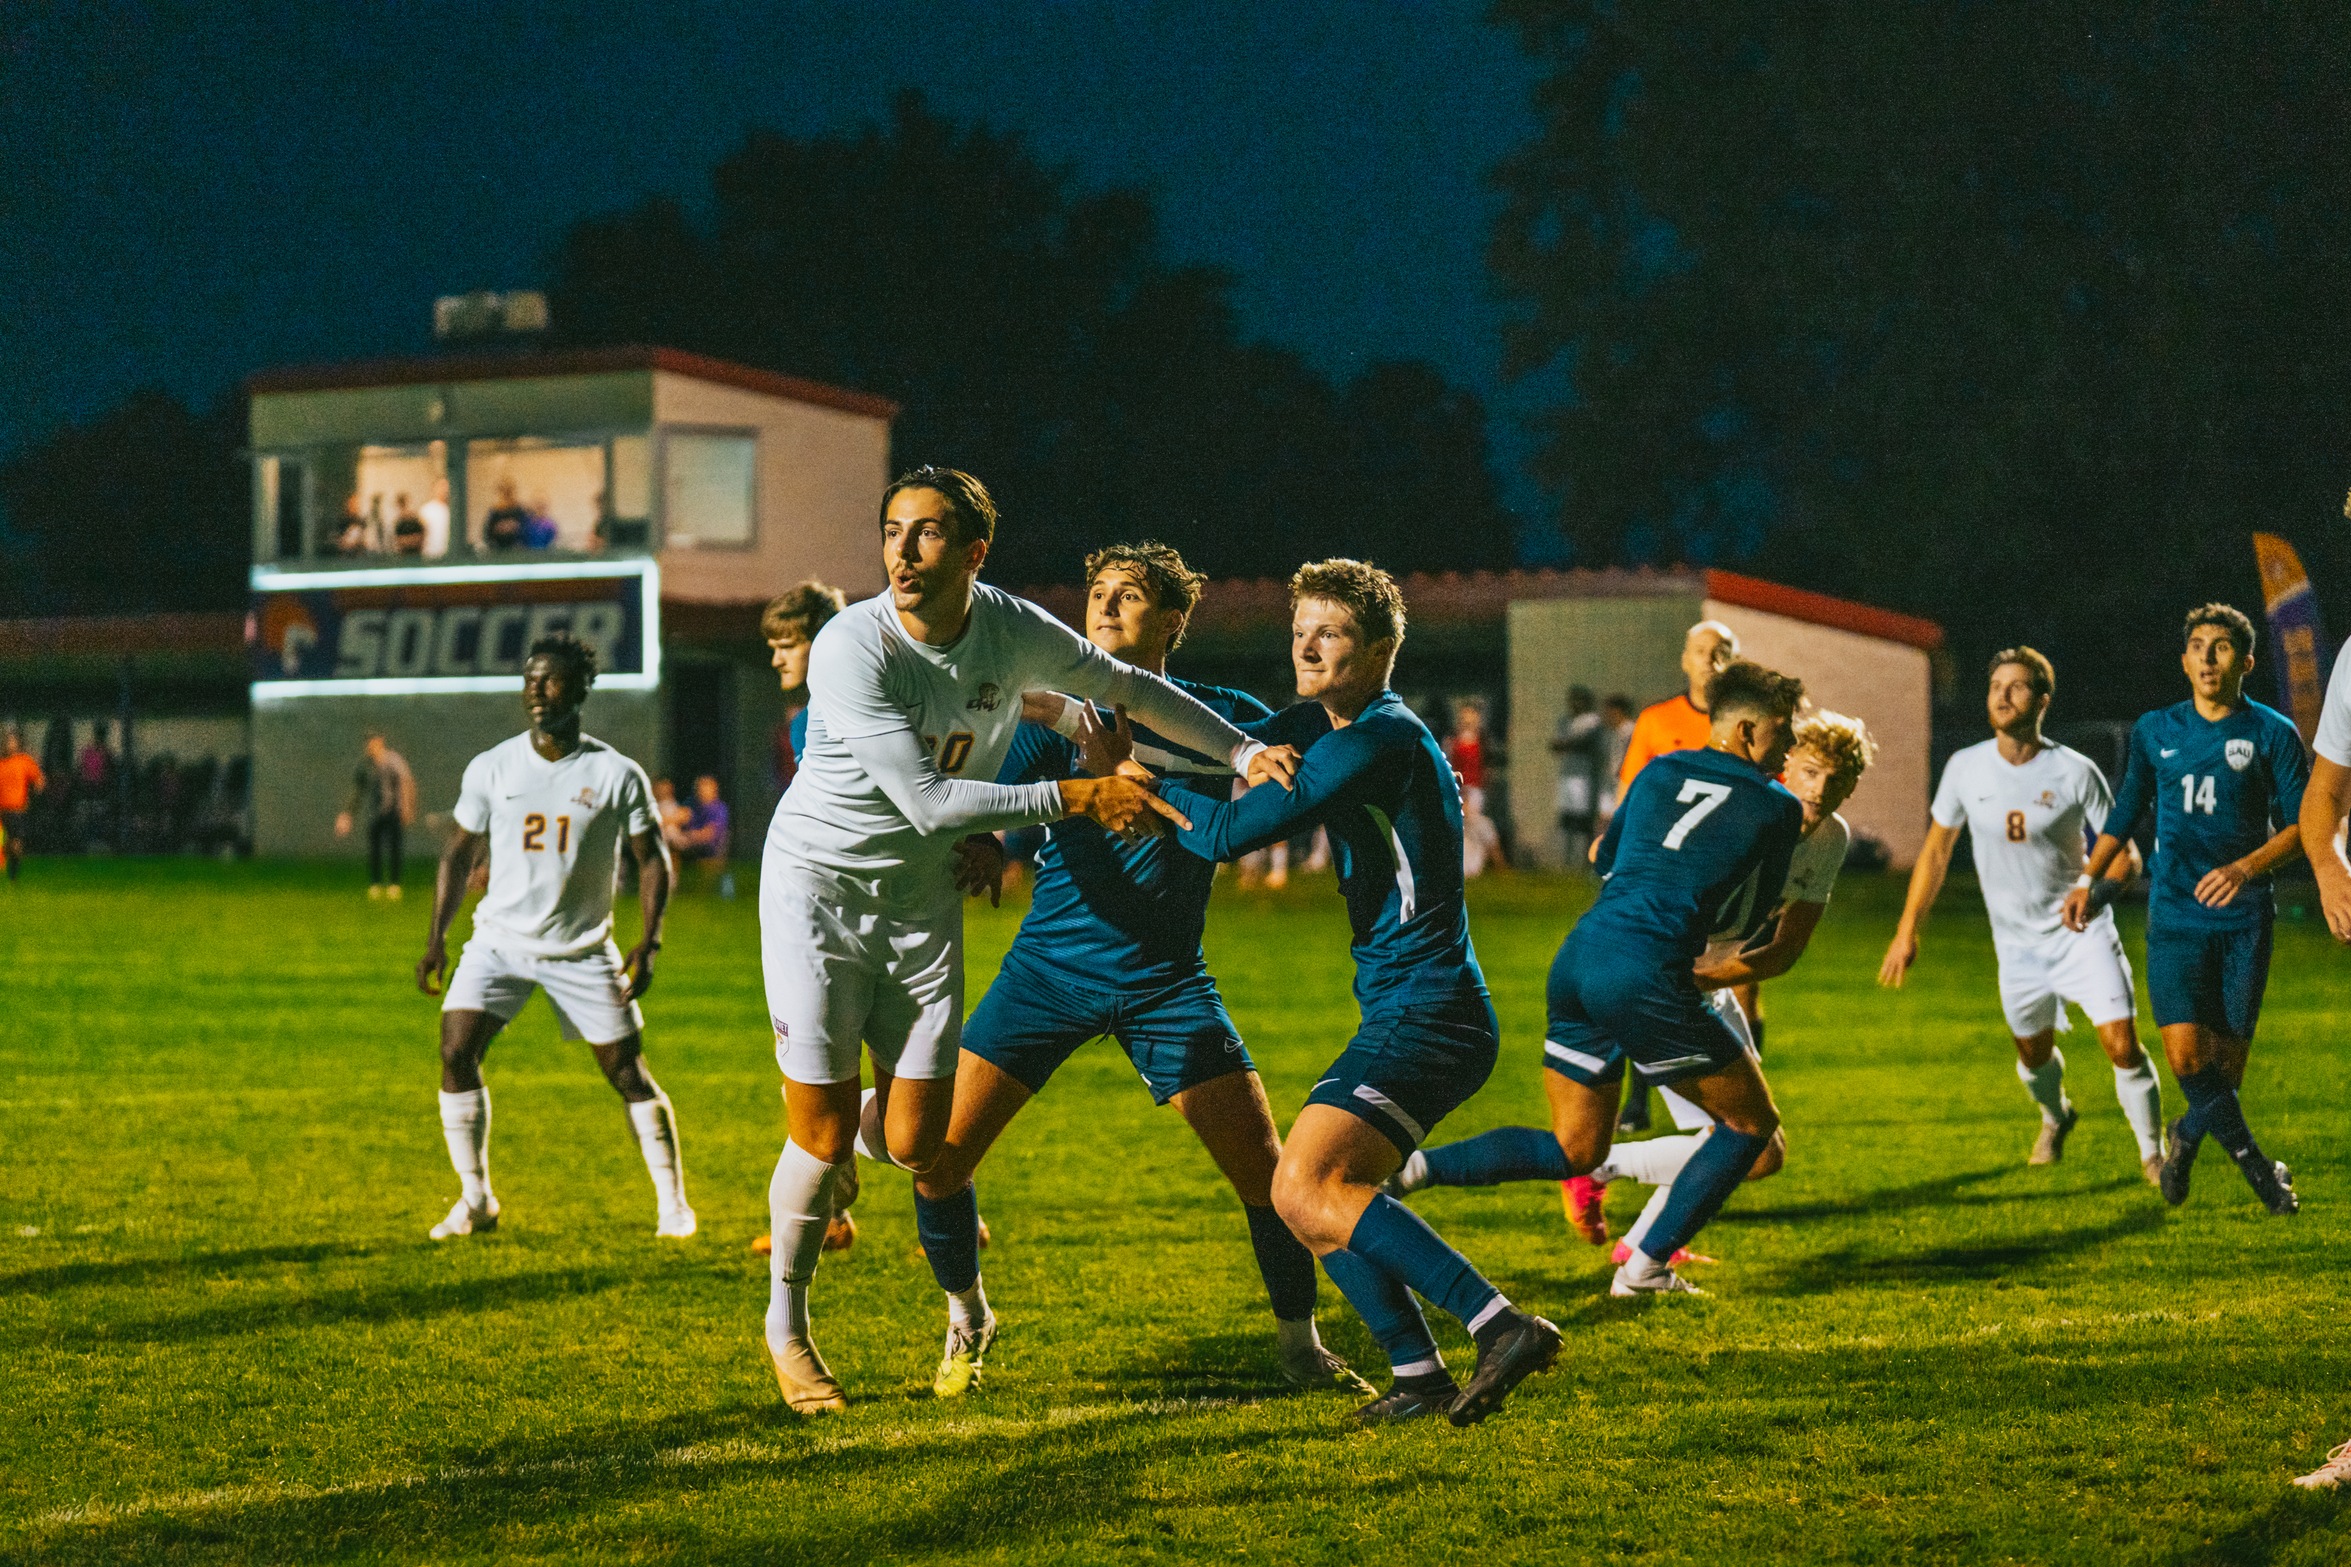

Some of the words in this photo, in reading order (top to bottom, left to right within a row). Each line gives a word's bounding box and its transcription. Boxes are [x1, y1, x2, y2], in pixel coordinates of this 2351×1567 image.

[924, 731, 975, 775] 0
[1661, 778, 1733, 851] 7
[2181, 773, 2217, 815] 14
[523, 812, 571, 854] 21
[2006, 809, 2027, 843] 8
